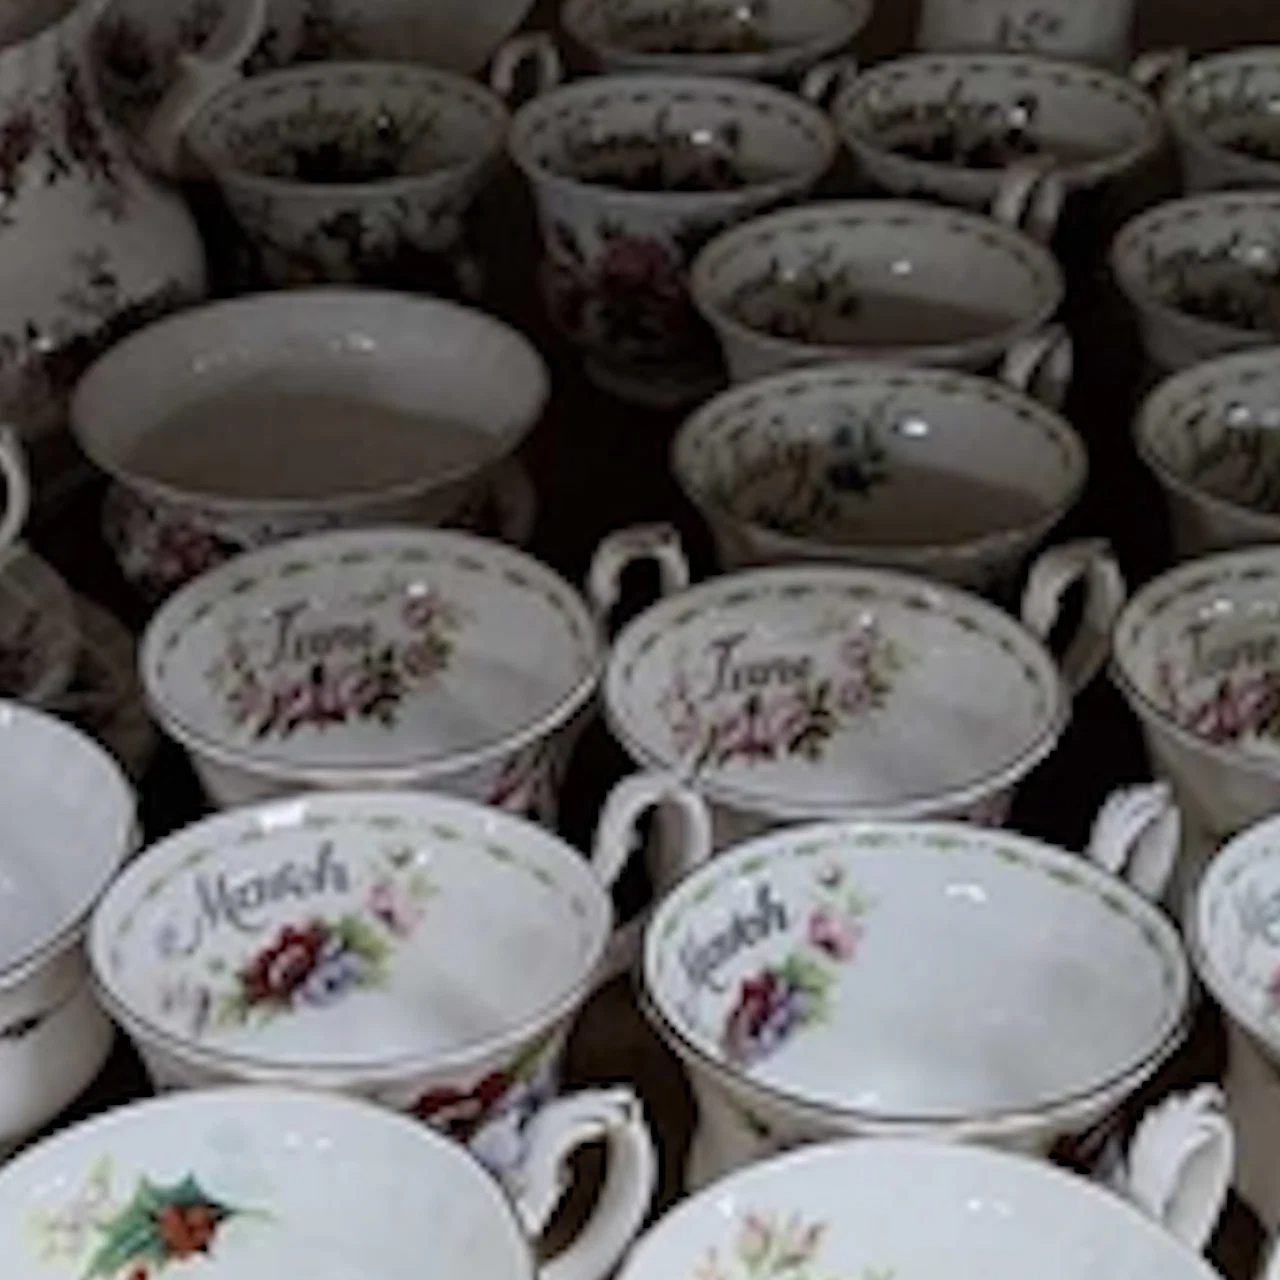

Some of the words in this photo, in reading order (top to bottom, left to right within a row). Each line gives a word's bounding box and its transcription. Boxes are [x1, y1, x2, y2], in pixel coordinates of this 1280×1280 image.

[260, 602, 376, 670] June
[707, 632, 814, 696] June
[192, 840, 350, 950] March
